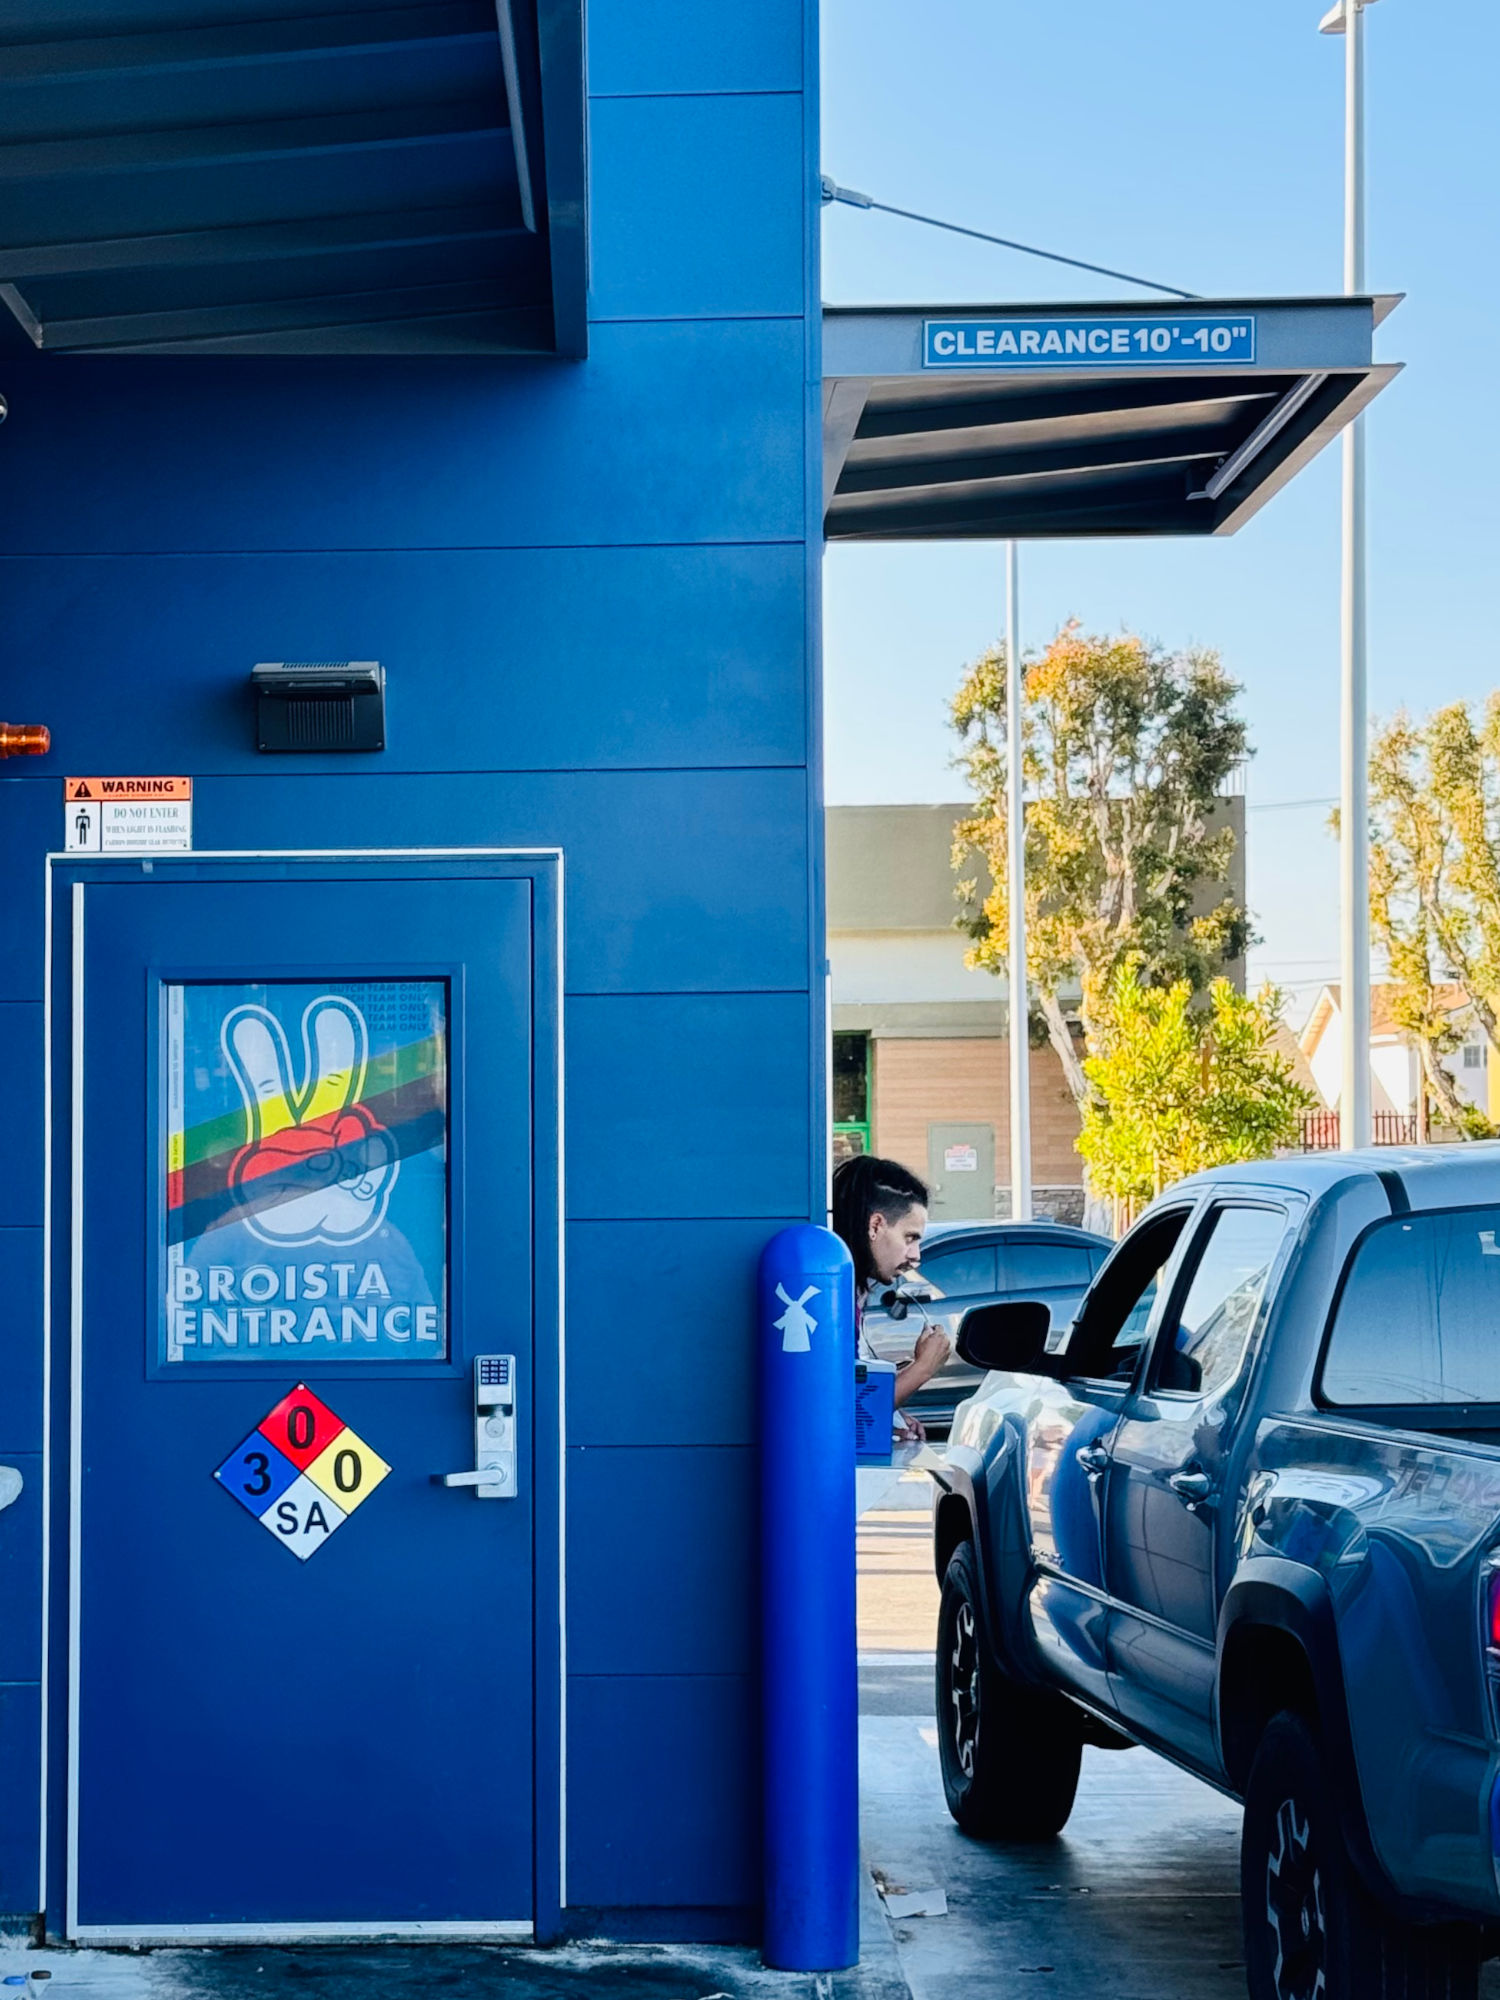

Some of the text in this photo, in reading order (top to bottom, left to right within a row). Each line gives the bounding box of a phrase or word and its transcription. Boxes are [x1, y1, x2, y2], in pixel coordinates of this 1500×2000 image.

[933, 326, 1247, 356] CLEARANCE 10'-10"
[101, 780, 175, 793] WARNING
[114, 807, 179, 818] DO NOT ENTER
[367, 984, 396, 992] TEAM
[367, 994, 396, 1002] TEAM
[399, 994, 428, 1002] ONLY
[367, 1003, 396, 1011] TEAM
[399, 1003, 427, 1011] ONLY
[367, 1013, 427, 1021] TEAM ONLY
[367, 1023, 427, 1031] TEAM ONLY
[175, 1263, 392, 1304] BROISTA
[175, 1304, 437, 1346] ENTRANCE
[287, 1405, 315, 1449] 0
[243, 1452, 272, 1496] 3
[333, 1449, 362, 1492] 0
[276, 1501, 330, 1535] SA
